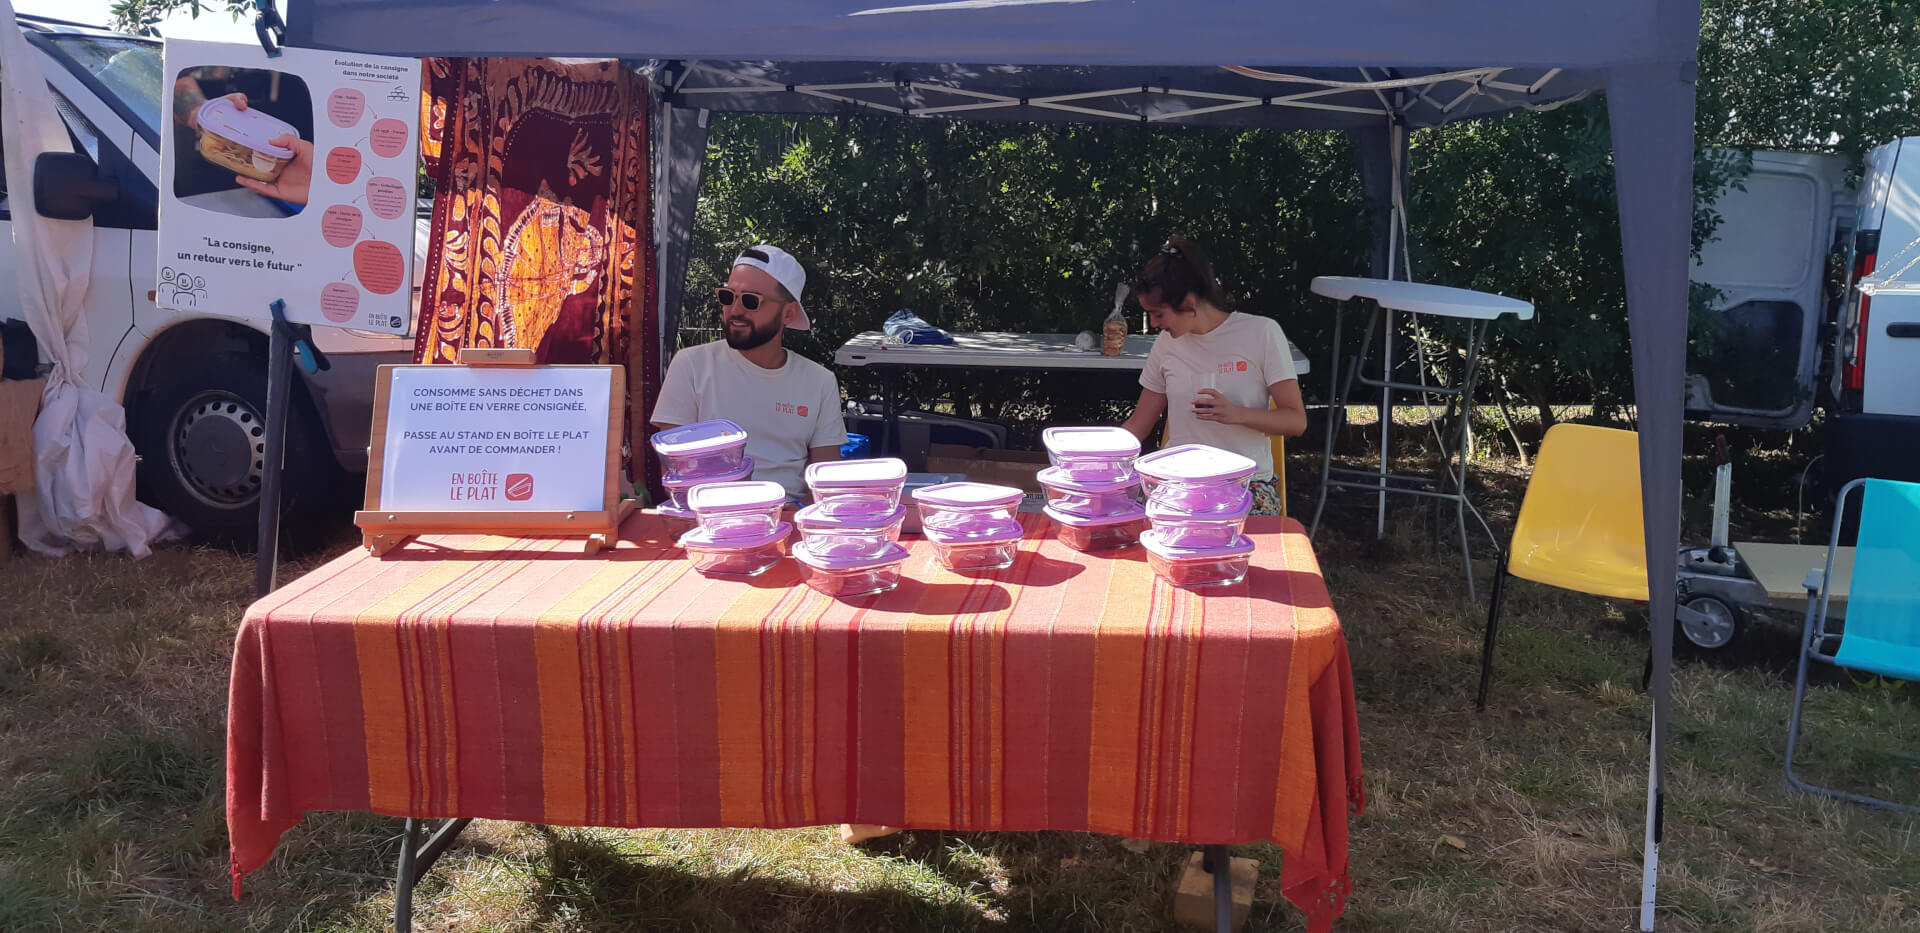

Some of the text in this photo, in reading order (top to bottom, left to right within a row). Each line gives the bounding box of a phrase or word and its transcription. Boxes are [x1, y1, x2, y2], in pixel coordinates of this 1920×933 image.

[381, 65, 409, 73] consigne
[222, 240, 274, 255] consigne,
[177, 251, 191, 261] un
[193, 253, 226, 265] retour
[229, 257, 251, 267] vers
[253, 258, 264, 269] le
[267, 260, 295, 272] futur
[413, 387, 583, 397] CONSOMME SANS DÉCHET DANS
[410, 401, 587, 412] UNE BOÎTE EN VERRE CONSIGNÉE,
[403, 429, 589, 440] PASSE AU STAND EN BOÎTE LE PLAT
[429, 445, 466, 454] AVANT
[468, 445, 482, 454] DE
[484, 445, 555, 454] COMMANDER
[451, 469, 499, 485] EN BOÎTE
[450, 486, 498, 501] LE PLAT
